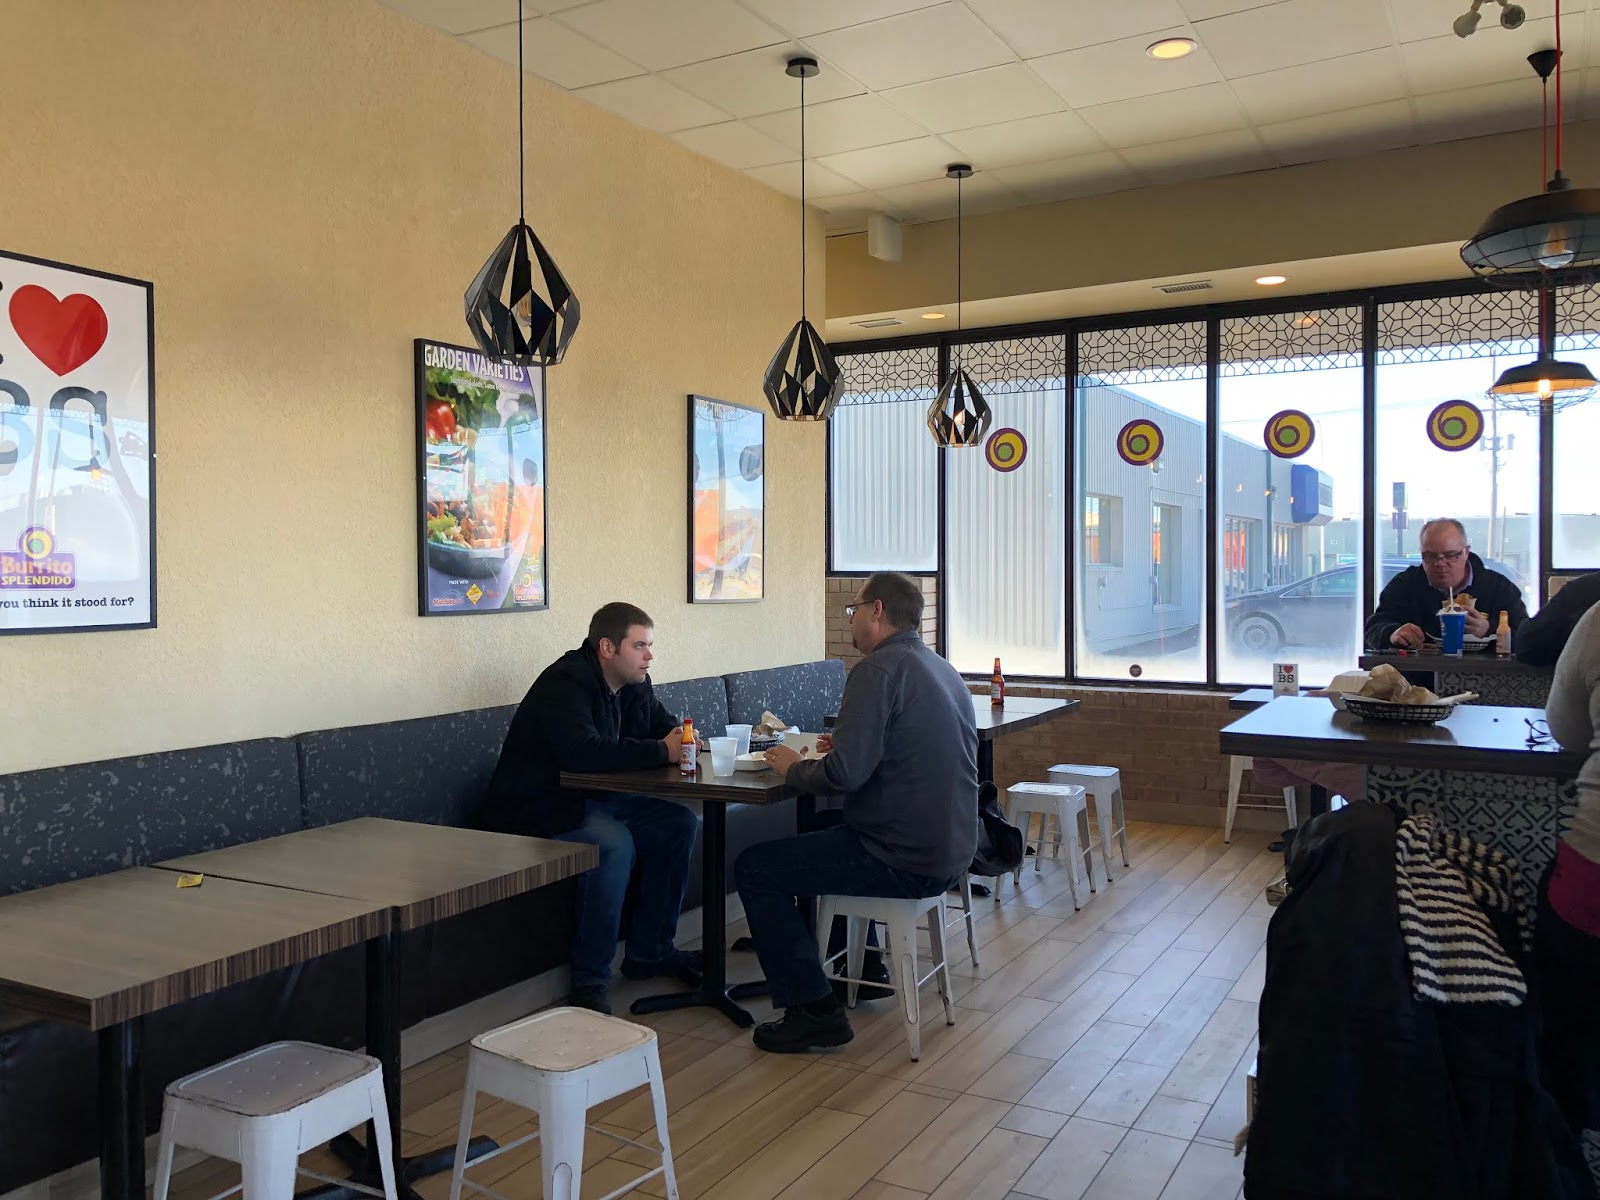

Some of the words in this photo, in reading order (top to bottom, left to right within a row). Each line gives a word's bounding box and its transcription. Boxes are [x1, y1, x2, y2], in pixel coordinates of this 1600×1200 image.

[424, 345, 470, 373] GARDEN
[1, 556, 73, 574] Burrito
[1, 575, 72, 585] SPLENDIDO
[22, 598, 59, 608] think
[61, 597, 72, 607] it
[74, 597, 107, 607] stood
[110, 596, 134, 607] for?
[1278, 665, 1283, 673] I
[1278, 674, 1294, 683] BS
